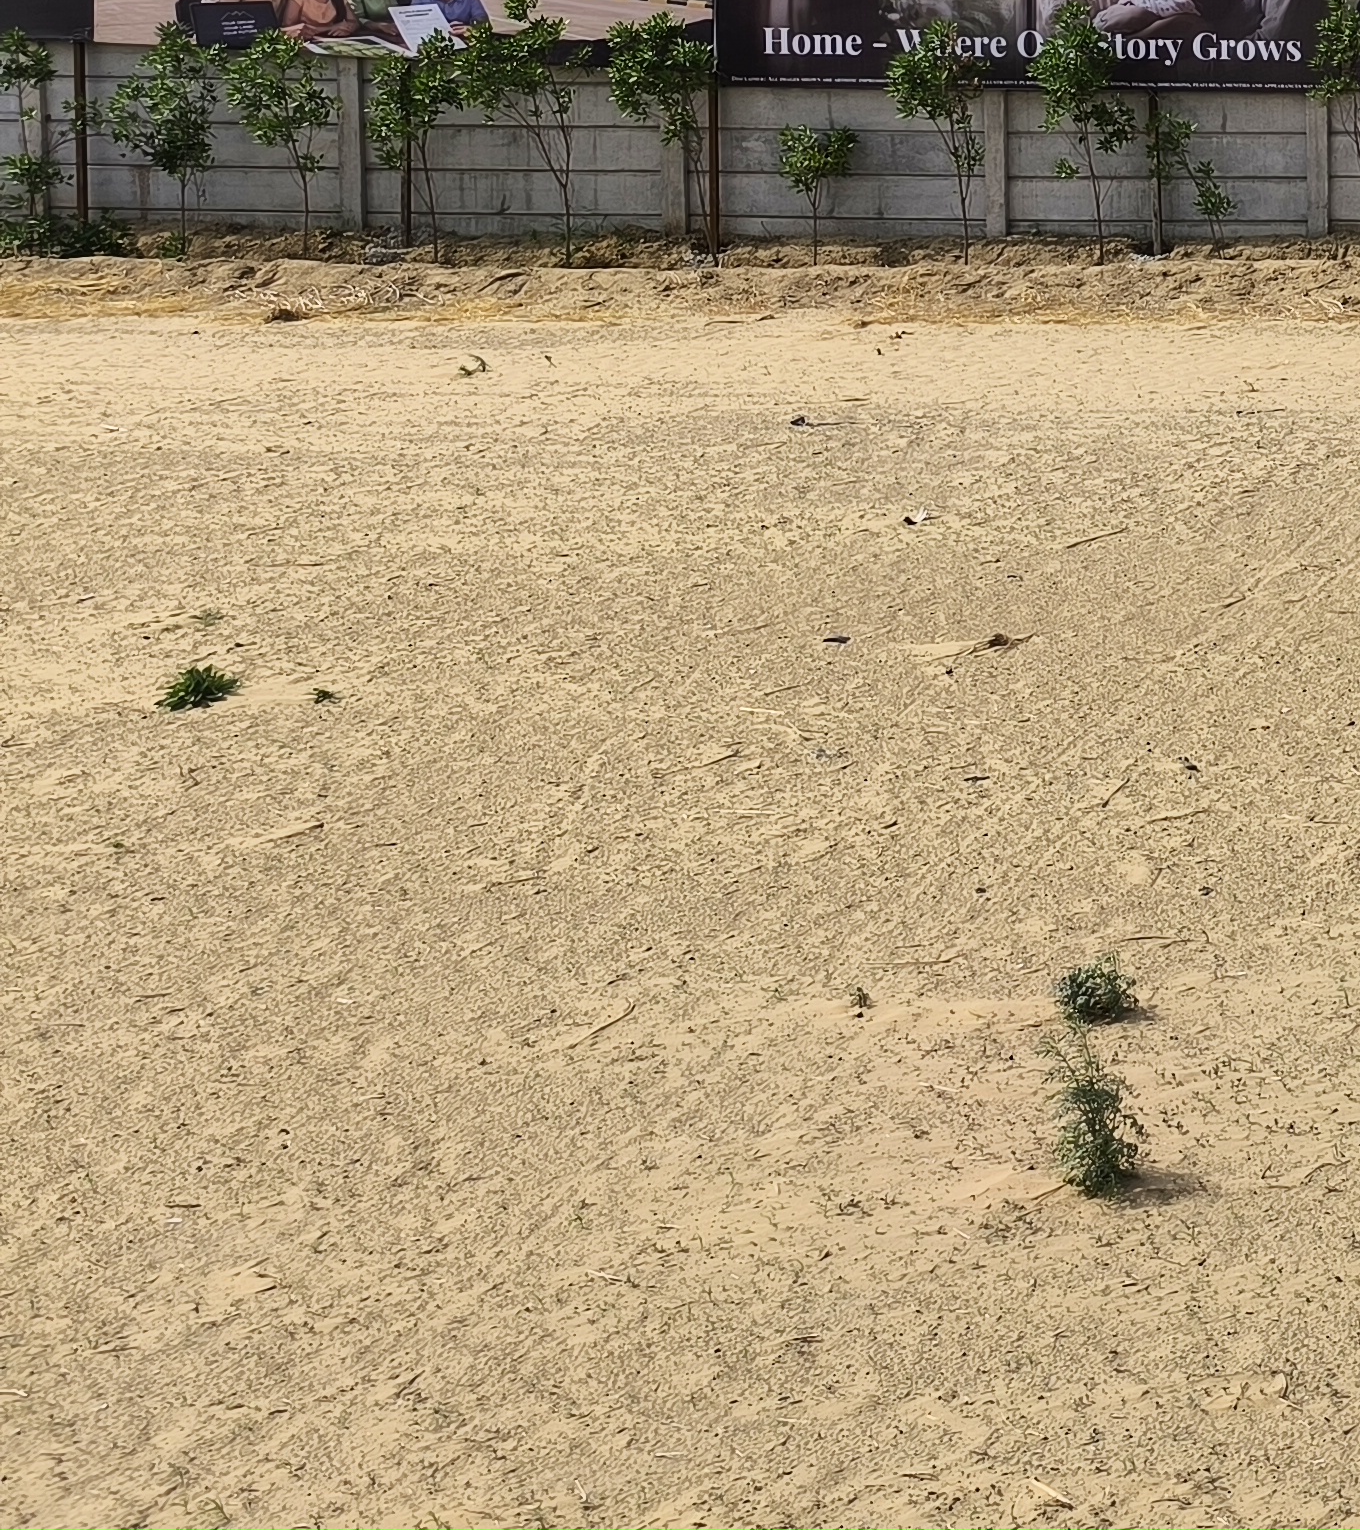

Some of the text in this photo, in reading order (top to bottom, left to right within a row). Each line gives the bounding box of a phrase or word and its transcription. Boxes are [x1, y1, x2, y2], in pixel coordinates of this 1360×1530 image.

[762, 27, 863, 56] Home
[896, 28, 1007, 58] Were
[1192, 32, 1302, 62] Grows
